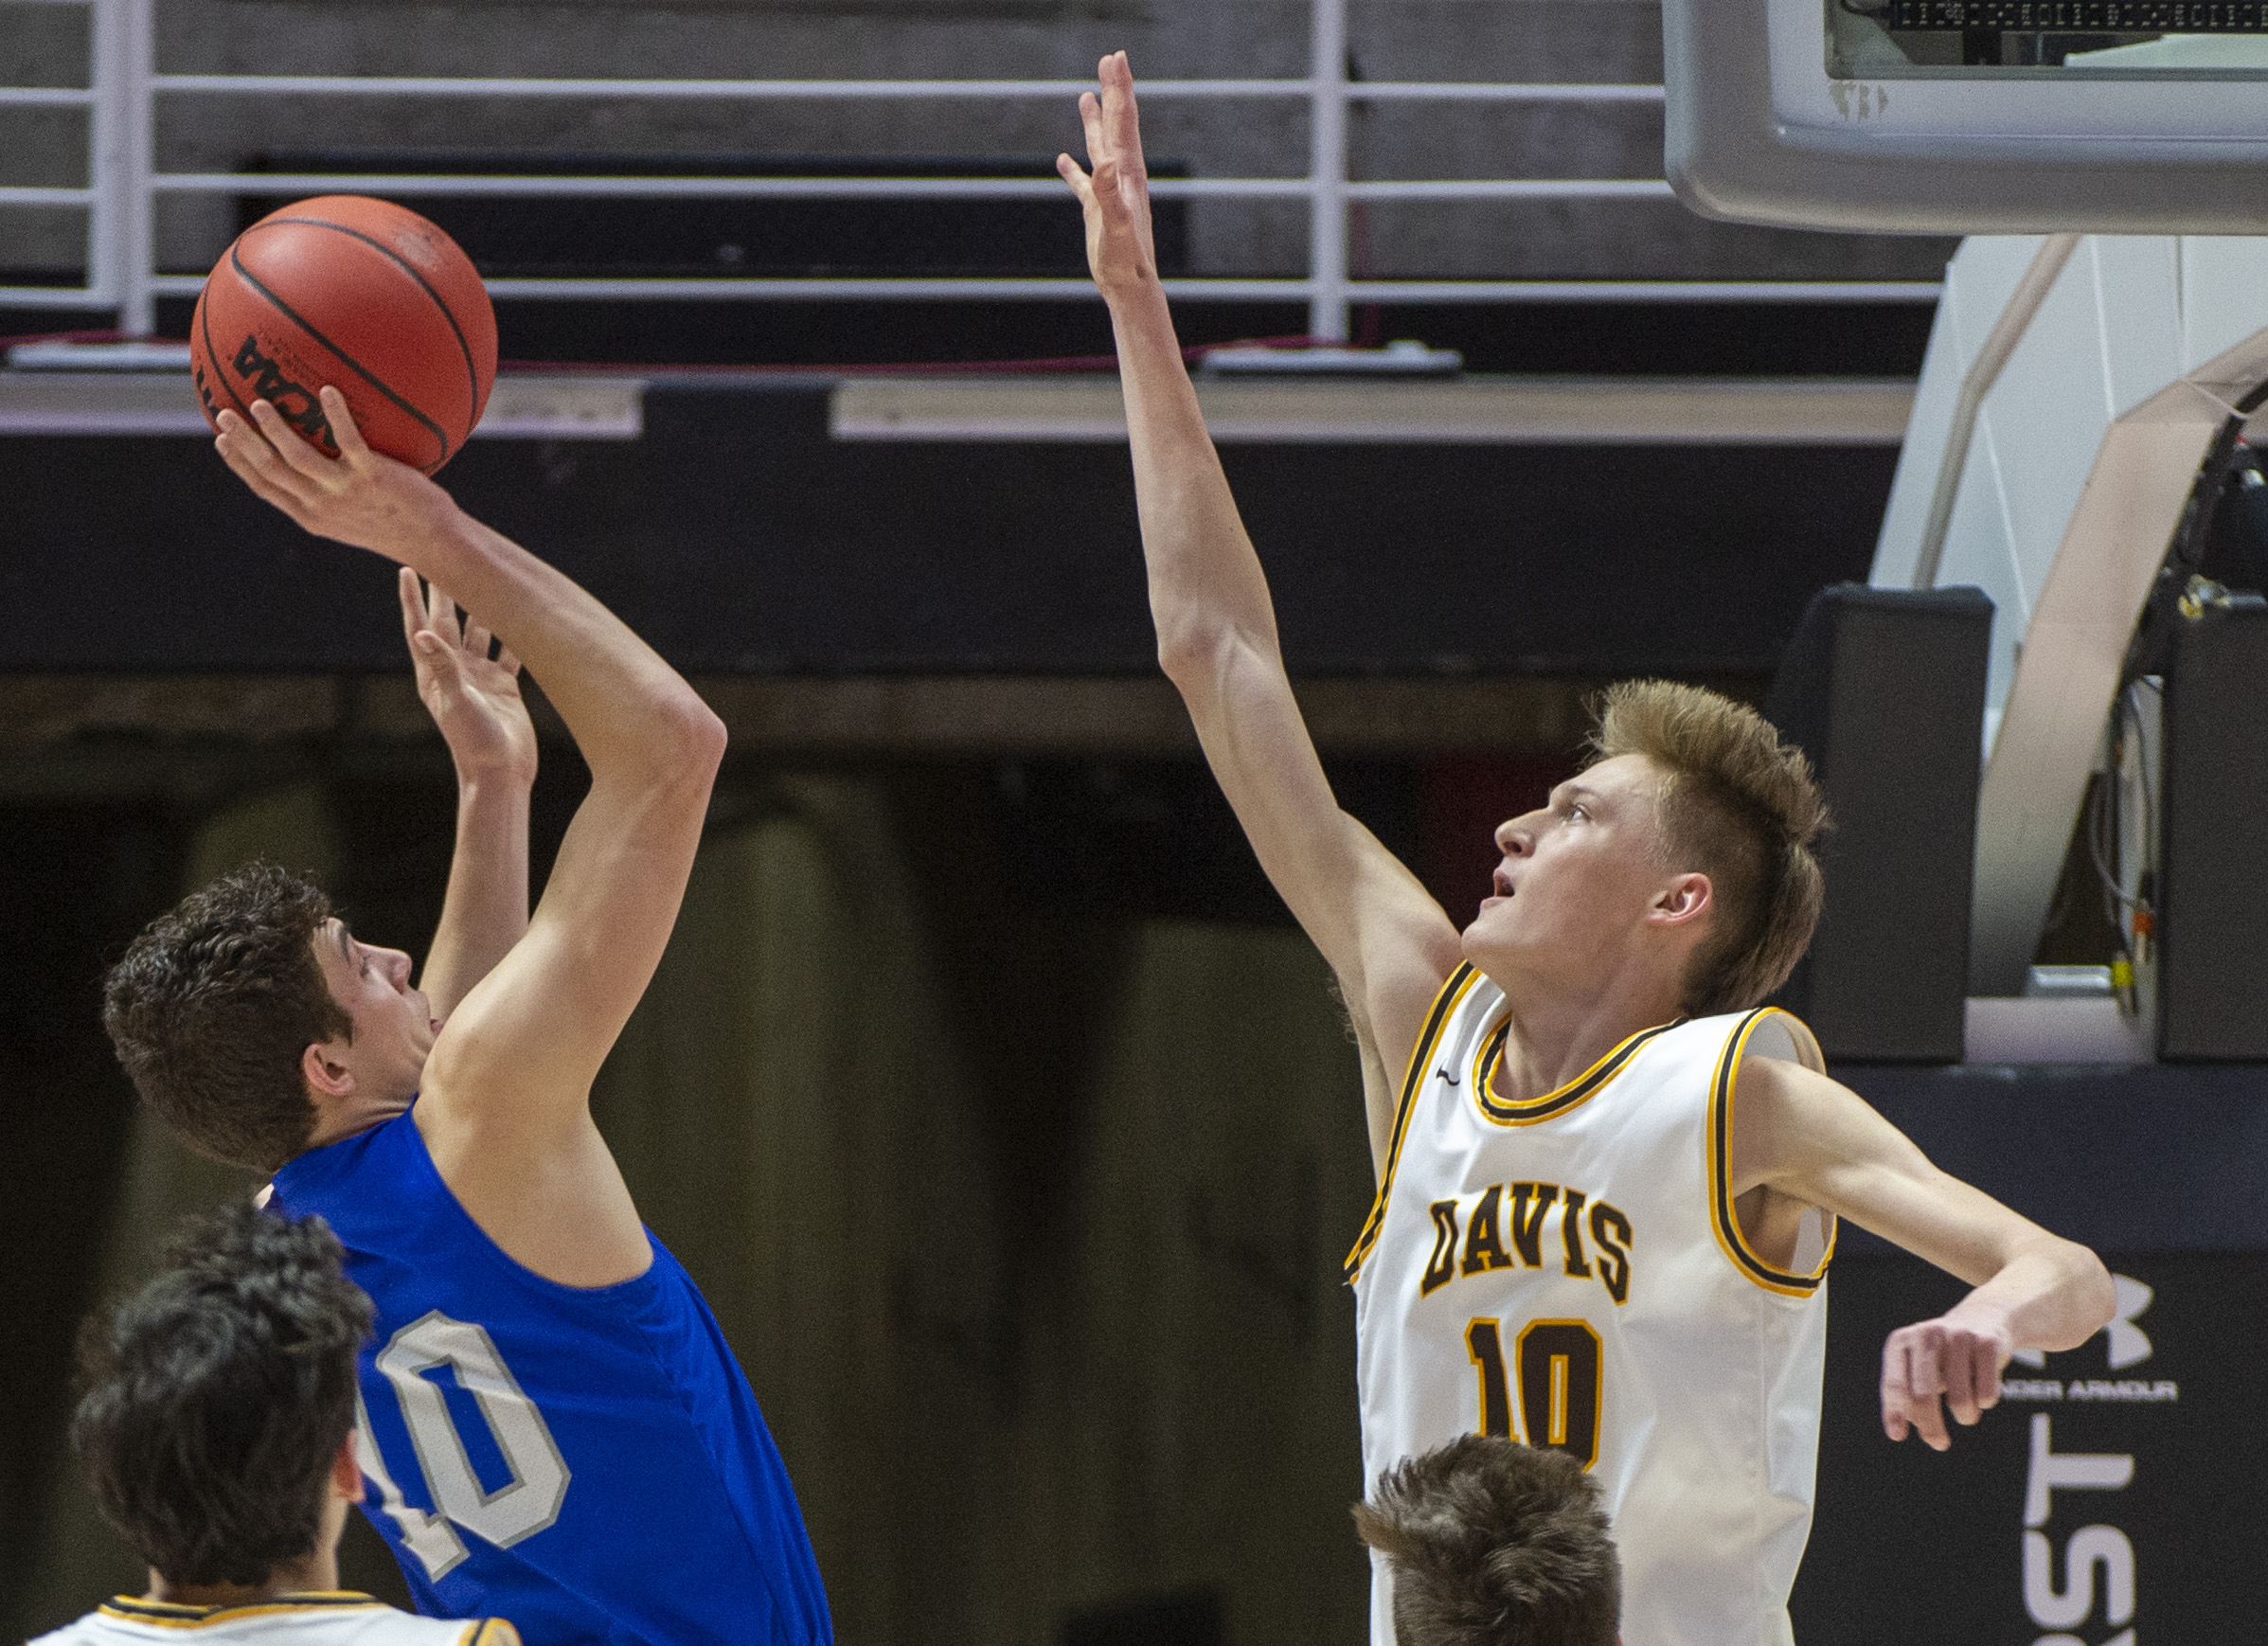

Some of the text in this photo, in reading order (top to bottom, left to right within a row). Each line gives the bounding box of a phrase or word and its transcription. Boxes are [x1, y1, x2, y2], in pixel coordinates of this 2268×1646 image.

[1420, 1181, 1634, 1305] DAVIS
[1464, 1317, 1603, 1474] 10
[2001, 1379, 2178, 1401] NDER ARMOUR
[2024, 1412, 2137, 1646] ST
